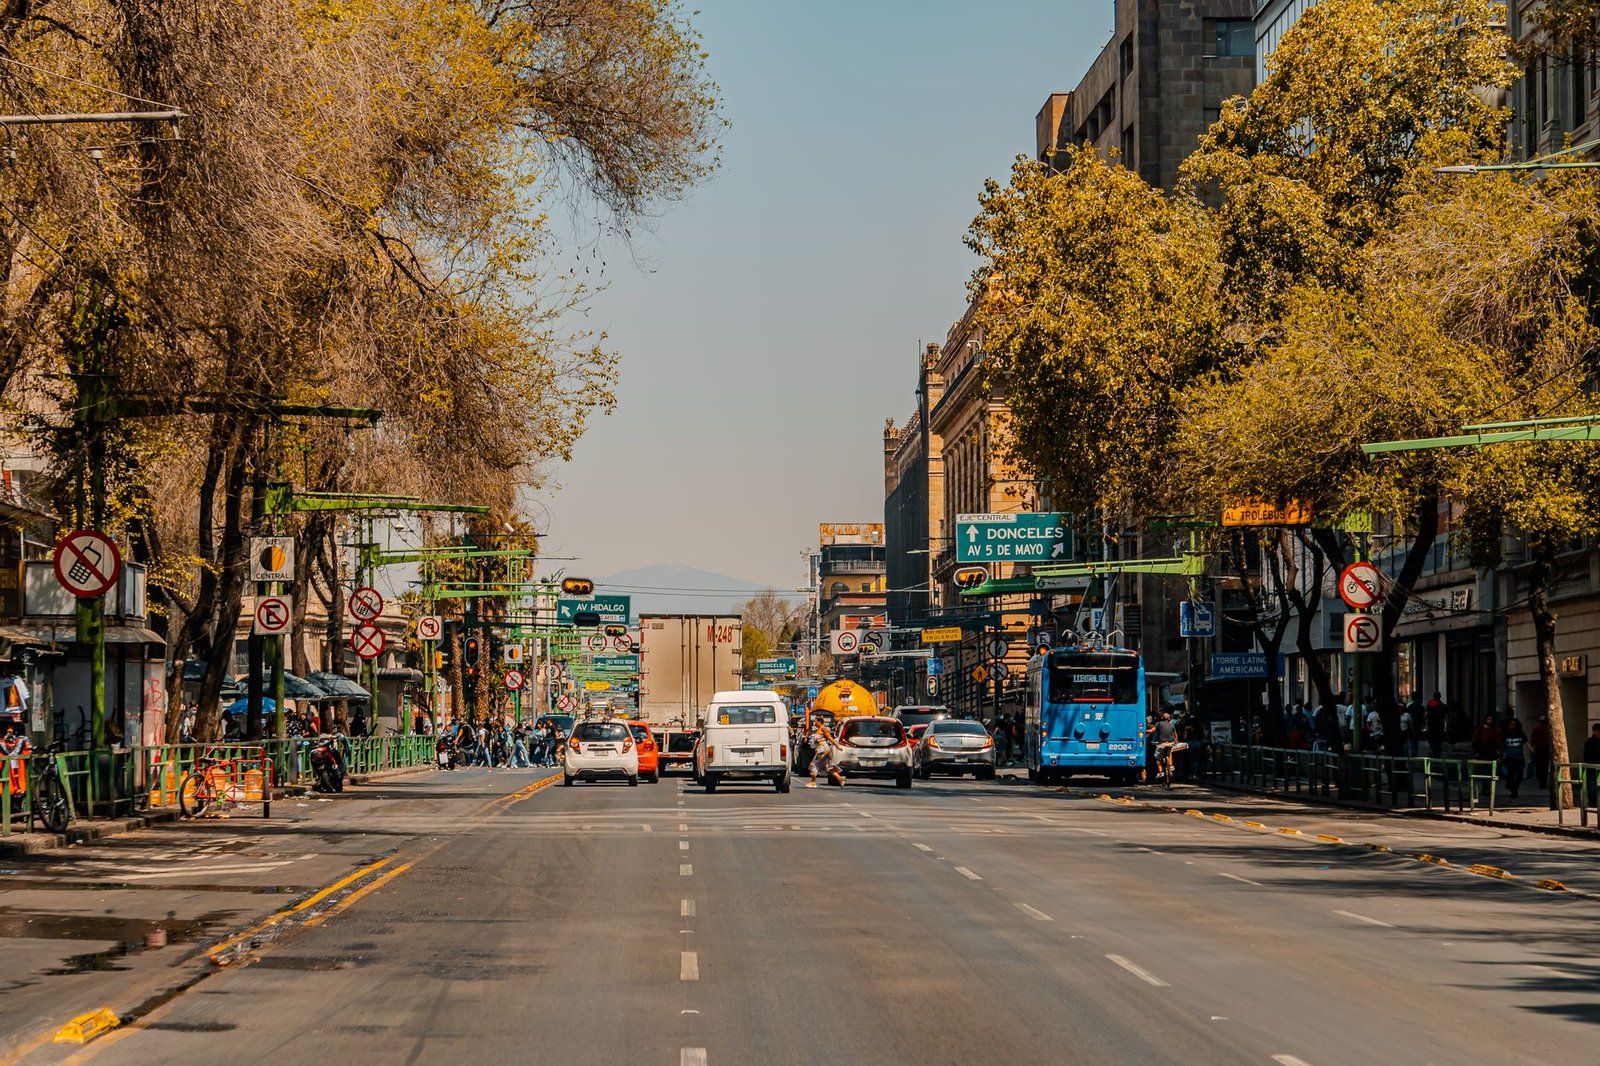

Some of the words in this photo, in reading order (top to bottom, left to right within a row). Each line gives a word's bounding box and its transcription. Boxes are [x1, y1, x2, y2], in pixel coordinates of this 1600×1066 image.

[977, 513, 1011, 521] CENTRAL
[1225, 511, 1236, 521] AL
[1240, 510, 1286, 520] TROLEBUS
[987, 527, 1064, 540] DONCELES
[967, 544, 981, 556] AV
[985, 544, 993, 556] 5
[997, 544, 1011, 556] DE
[1015, 543, 1044, 555] MAYO
[255, 572, 289, 580] CENTRAL
[576, 603, 588, 611] AV
[590, 603, 625, 612] HIDALGO
[1215, 656, 1240, 665] TORRE
[1219, 666, 1265, 674] AMERICANA
[1108, 743, 1132, 751] 22024
